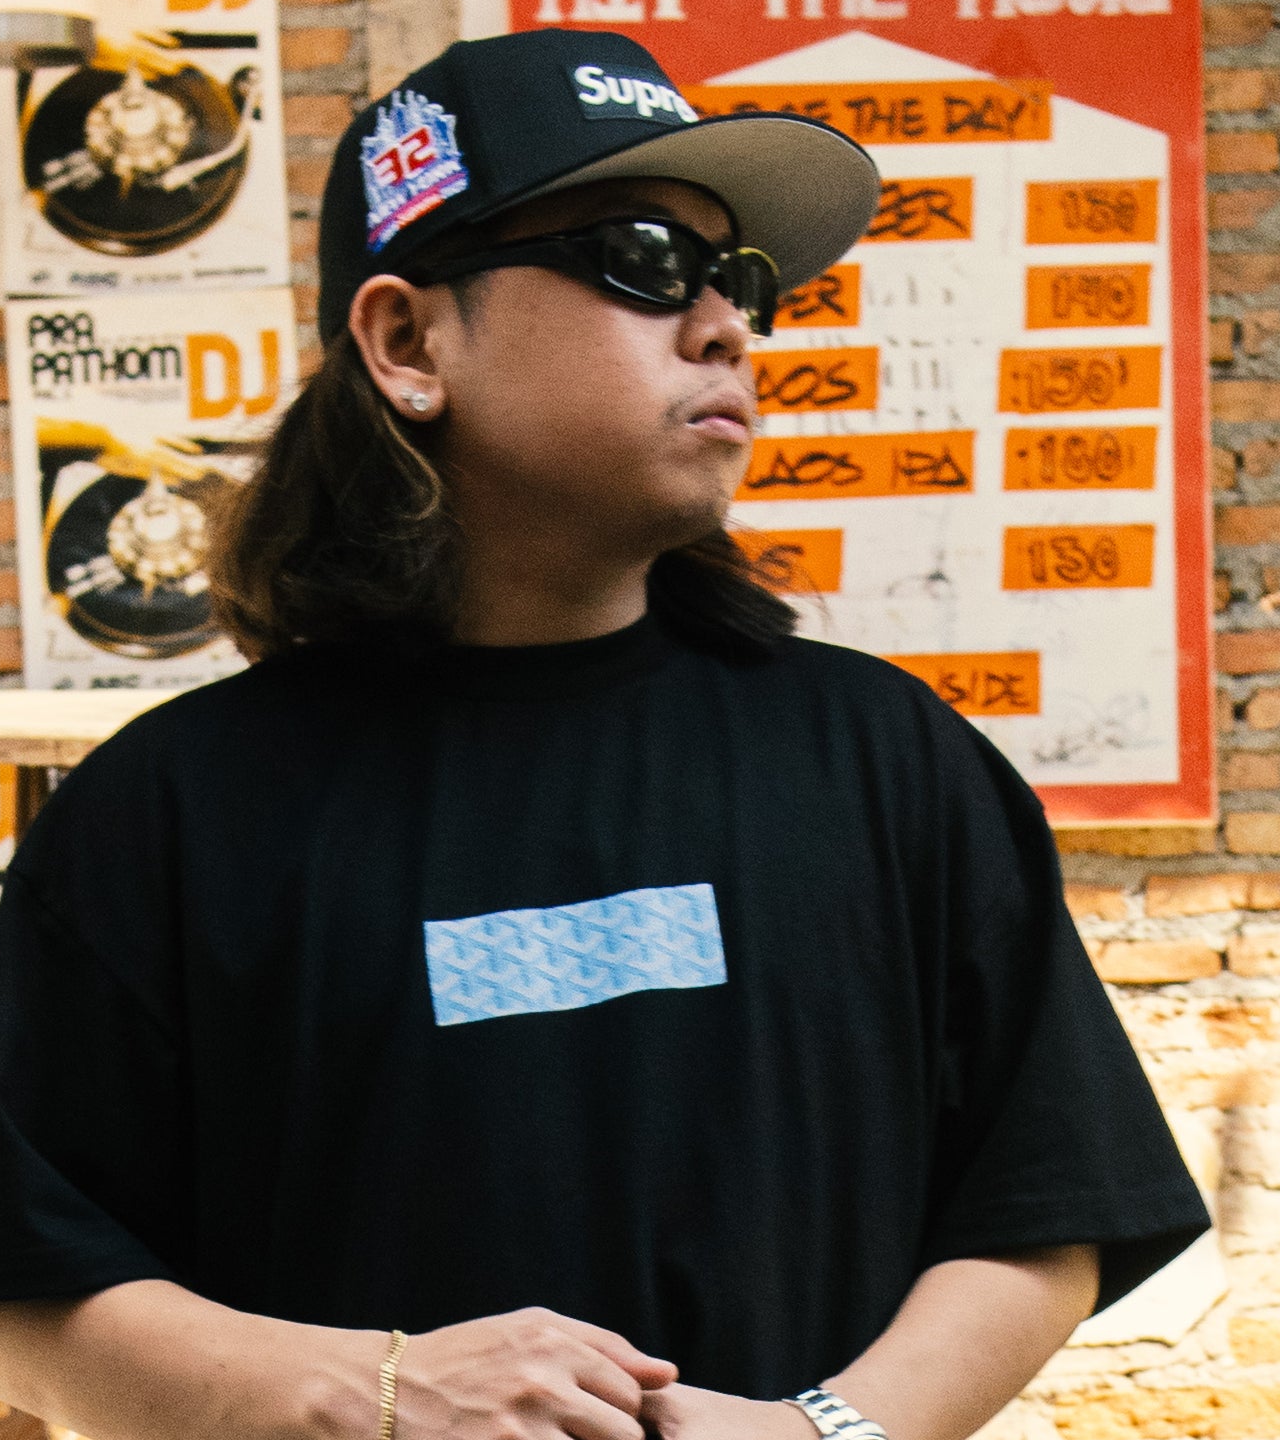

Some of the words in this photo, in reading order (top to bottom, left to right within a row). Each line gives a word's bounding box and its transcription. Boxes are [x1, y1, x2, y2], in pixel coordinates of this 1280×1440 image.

[573, 64, 700, 124] Supre
[845, 94, 928, 139] THE
[185, 328, 280, 420] DJ
[756, 360, 859, 406] AOS
